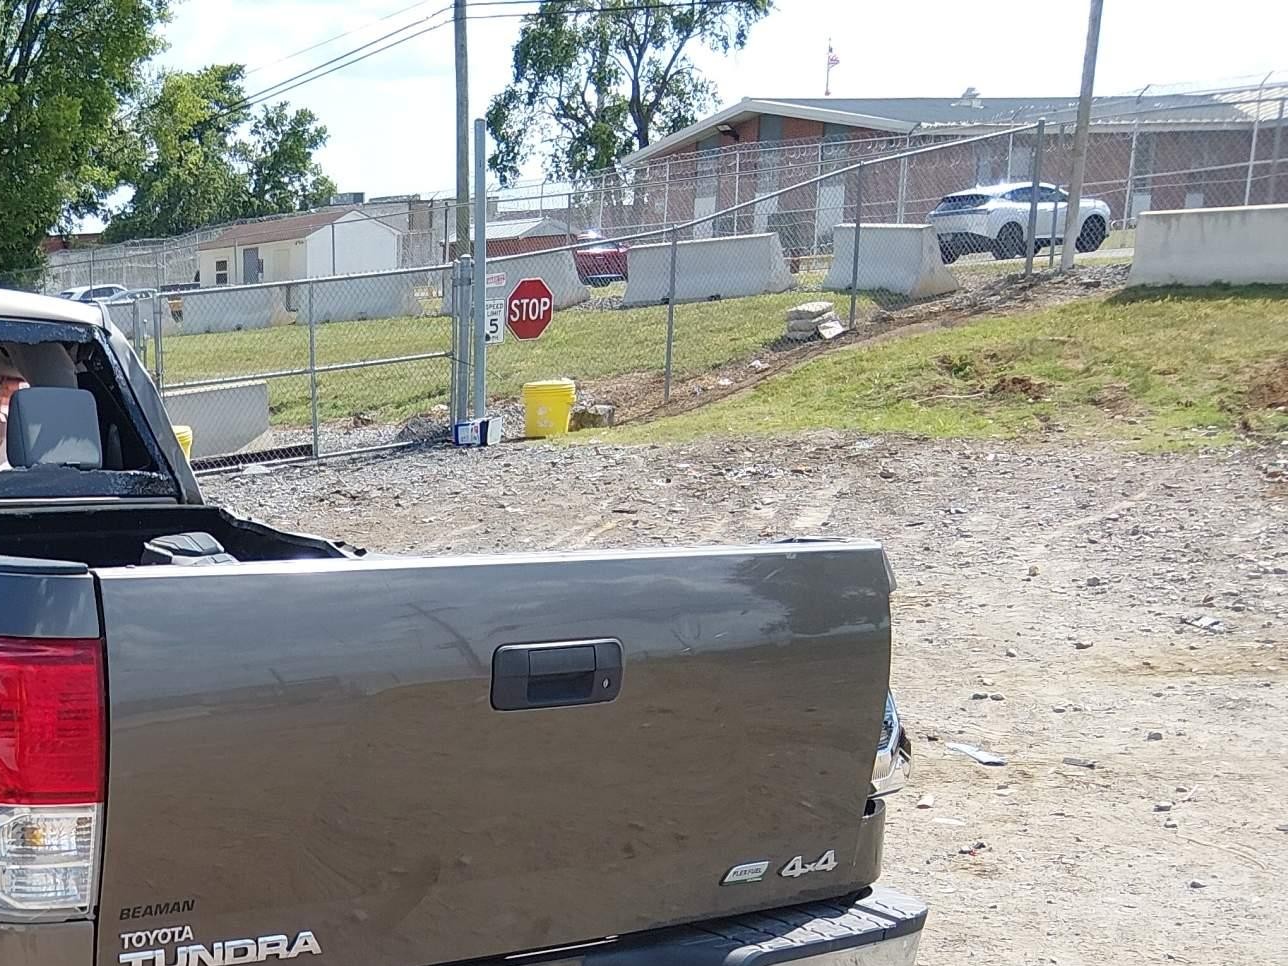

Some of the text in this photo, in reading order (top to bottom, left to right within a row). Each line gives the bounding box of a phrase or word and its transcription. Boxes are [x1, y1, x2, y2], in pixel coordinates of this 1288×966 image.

[510, 297, 550, 322] STOP
[489, 318, 499, 334] 5
[781, 849, 839, 878] 4x4
[119, 899, 196, 920] BEAMAN
[120, 925, 194, 949] TOYOTA
